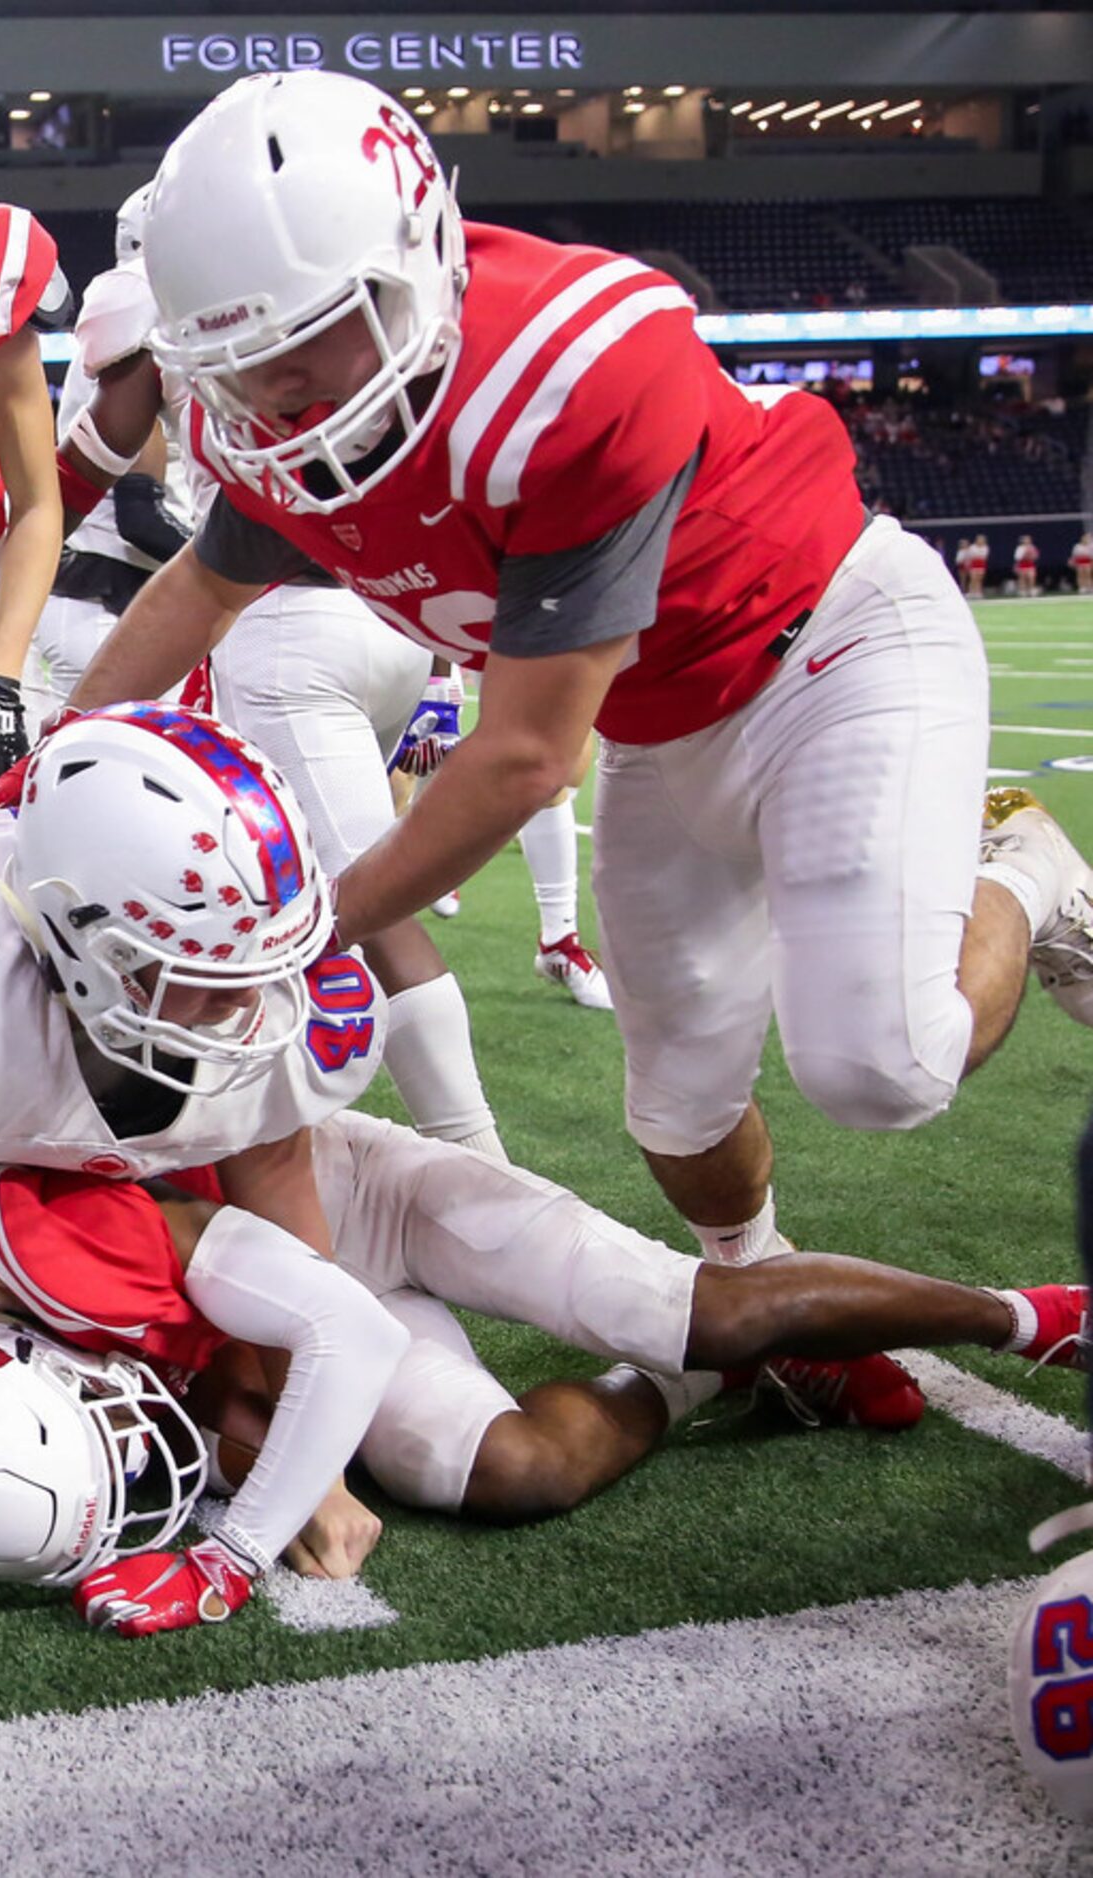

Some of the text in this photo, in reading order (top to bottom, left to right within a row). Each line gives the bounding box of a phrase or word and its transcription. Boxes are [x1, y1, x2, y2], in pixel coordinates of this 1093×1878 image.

[162, 33, 583, 72] FORD CENTER
[304, 954, 375, 1073] 40
